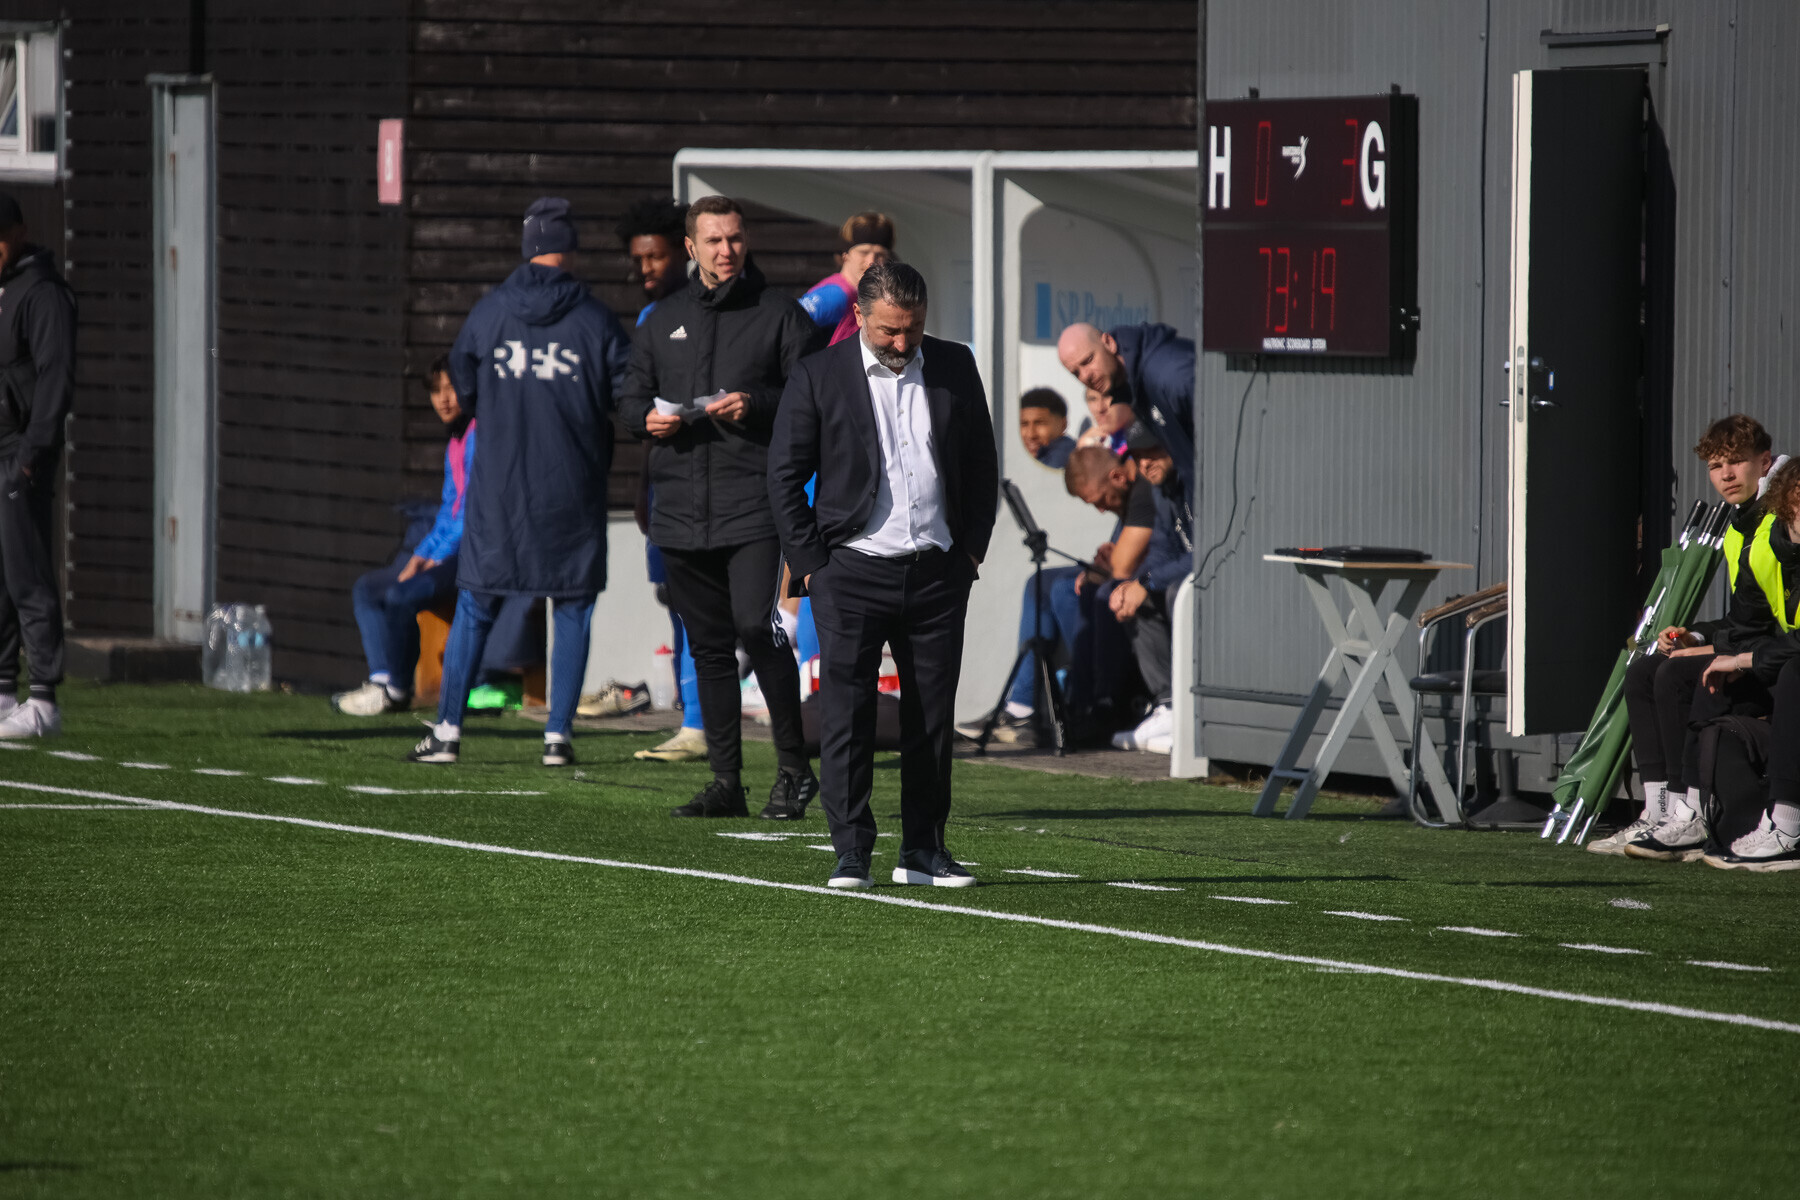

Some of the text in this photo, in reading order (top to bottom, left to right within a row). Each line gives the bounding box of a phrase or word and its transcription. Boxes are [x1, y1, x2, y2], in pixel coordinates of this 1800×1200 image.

[1207, 125, 1232, 210] H
[1341, 119, 1358, 206] 3
[1360, 121, 1386, 211] G
[1259, 247, 1336, 333] 73:19
[1658, 787, 1666, 813] adidas
